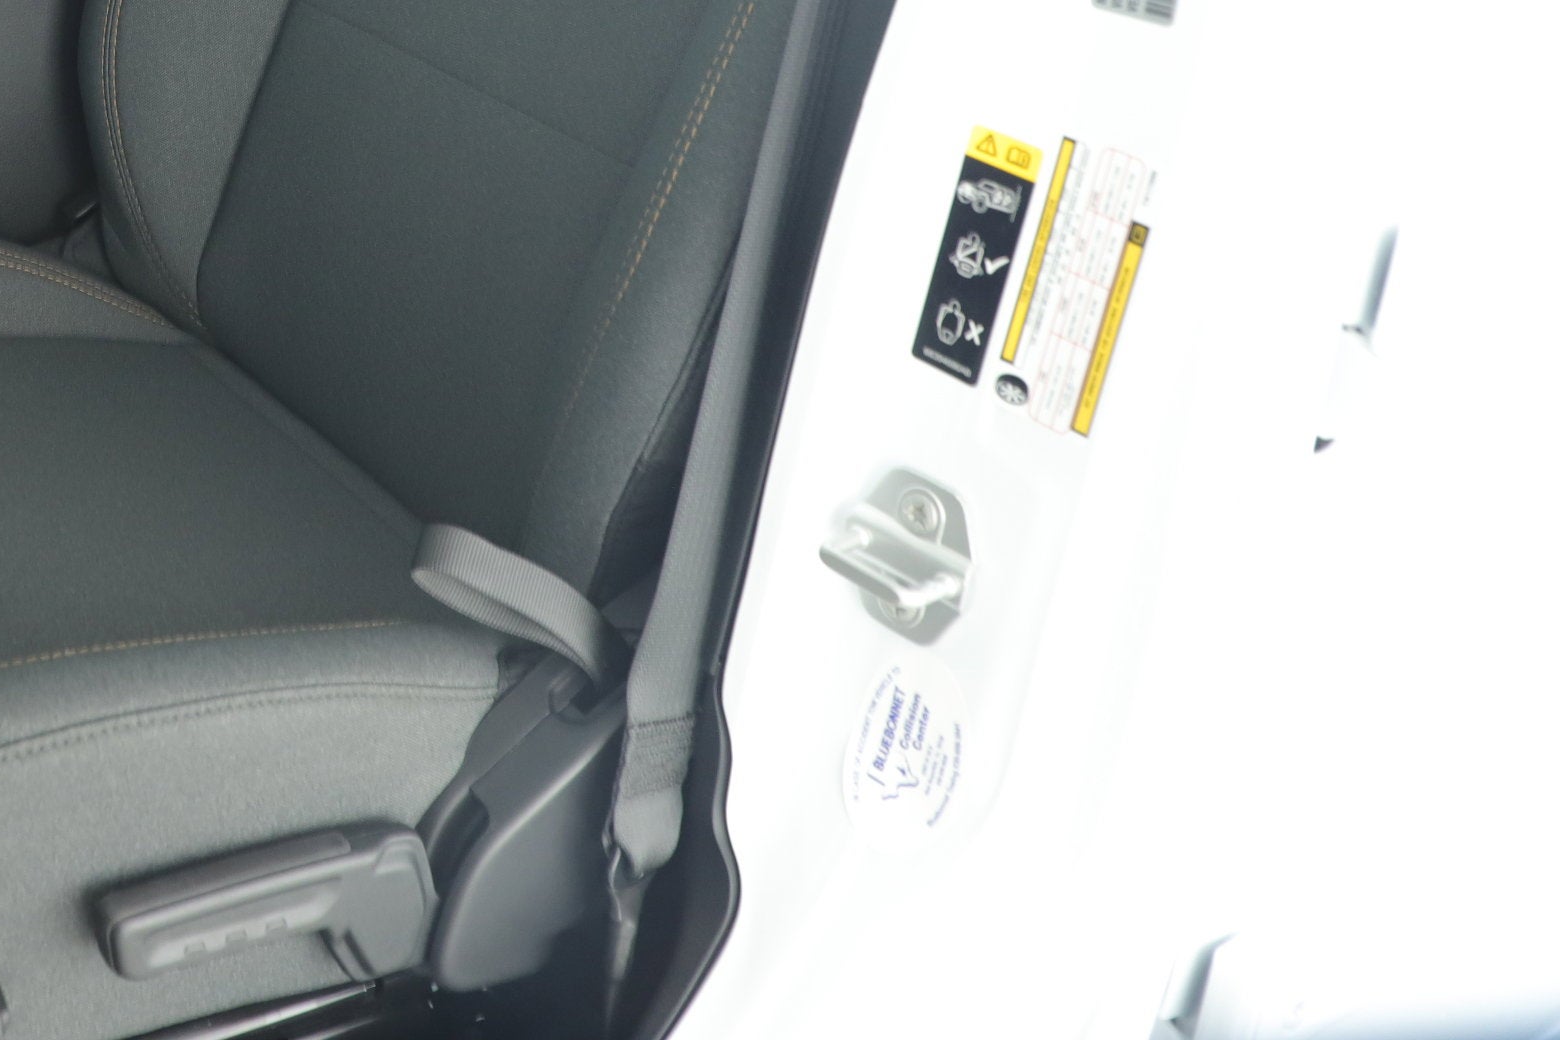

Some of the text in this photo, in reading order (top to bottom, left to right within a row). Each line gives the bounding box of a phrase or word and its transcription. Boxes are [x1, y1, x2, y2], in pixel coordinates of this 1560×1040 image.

[872, 685, 906, 772] BLUEBONNET
[899, 693, 921, 750] Collision
[912, 705, 930, 751] Center
